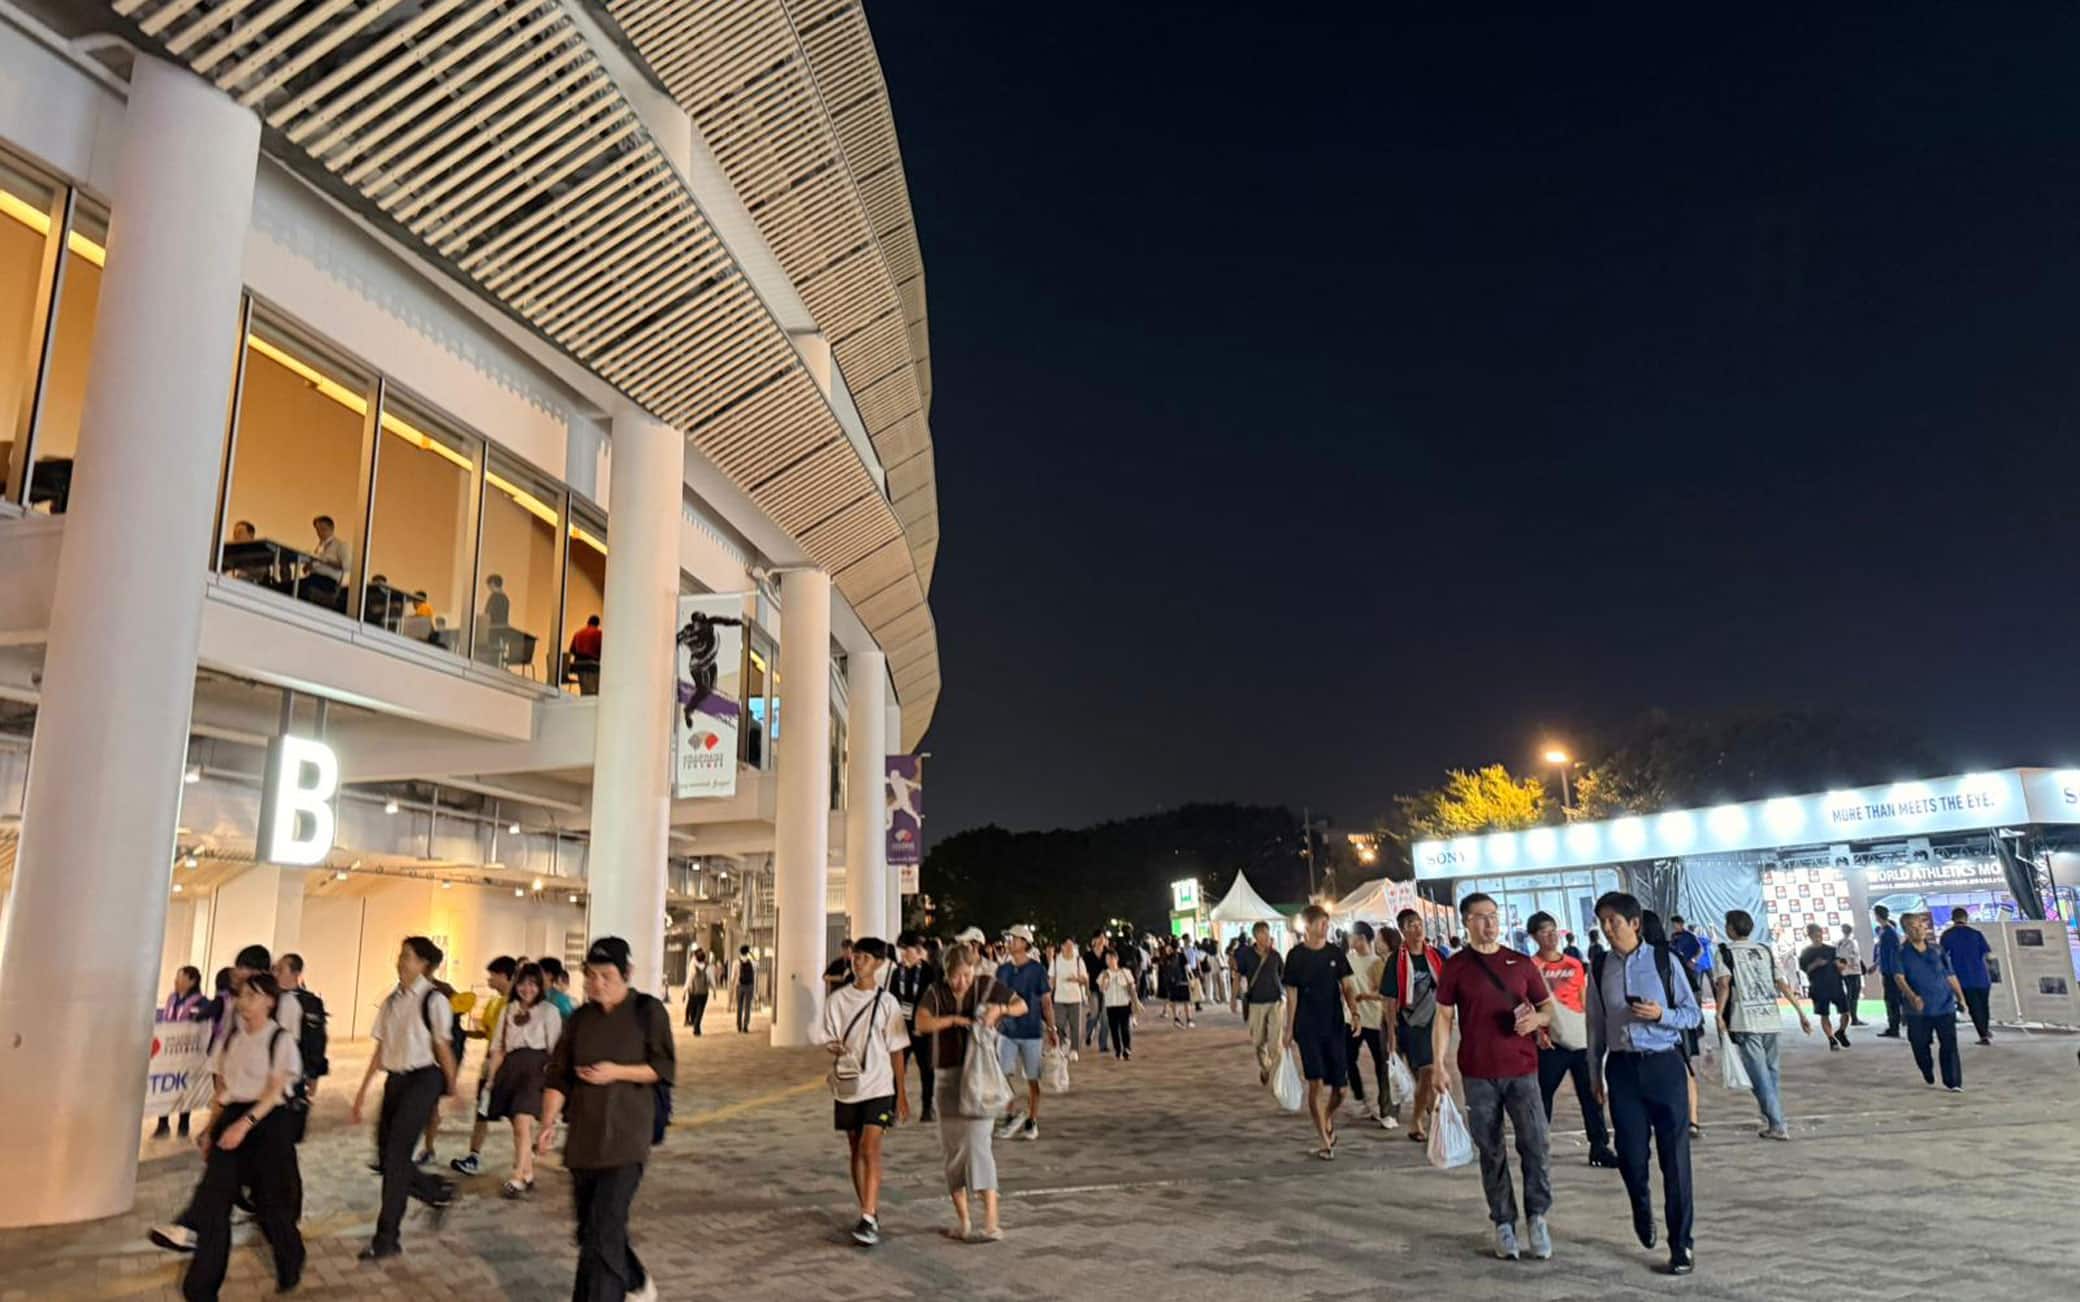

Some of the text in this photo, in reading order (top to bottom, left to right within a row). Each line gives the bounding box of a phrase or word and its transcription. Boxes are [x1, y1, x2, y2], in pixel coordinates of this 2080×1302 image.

[269, 734, 339, 866] B
[1832, 806, 1862, 823] MORE
[1865, 803, 1896, 819] THAN
[1899, 798, 1937, 815] MEETS
[1940, 795, 1964, 811] THE
[1425, 850, 1465, 865] SONY
[1912, 864, 1976, 880] ATHLETICS
[150, 1072, 189, 1094] TDK
